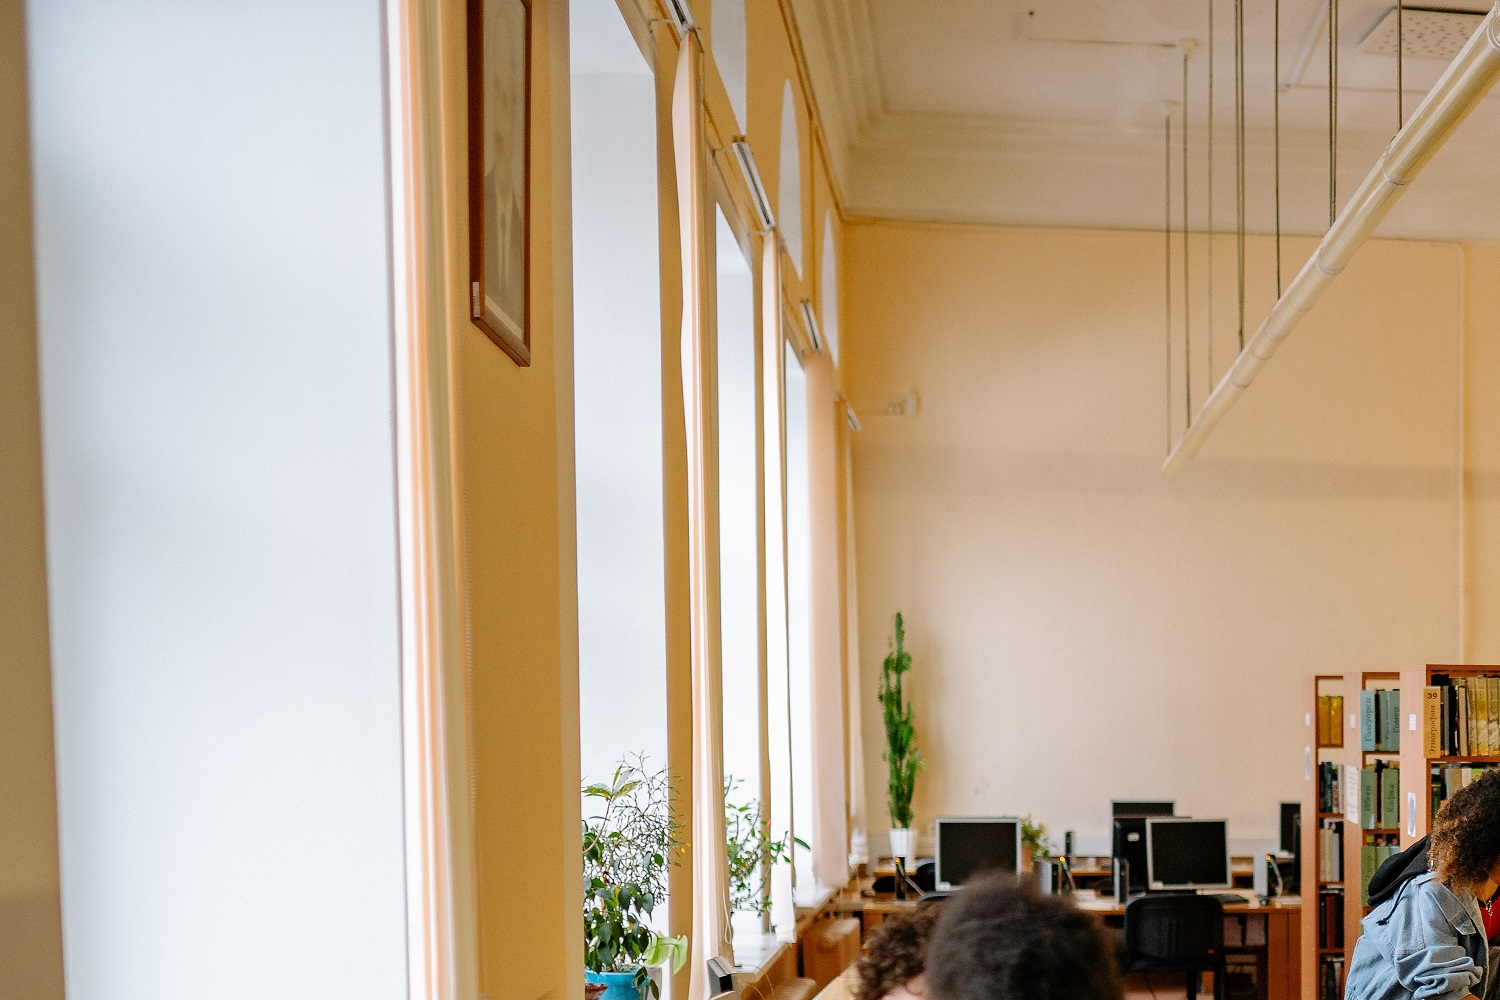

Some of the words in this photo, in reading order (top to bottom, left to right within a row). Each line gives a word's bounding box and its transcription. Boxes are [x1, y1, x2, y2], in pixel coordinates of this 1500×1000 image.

[1427, 692, 1438, 700] 39
[1428, 704, 1438, 755] Этнография
[1387, 784, 1397, 813] Кафка
